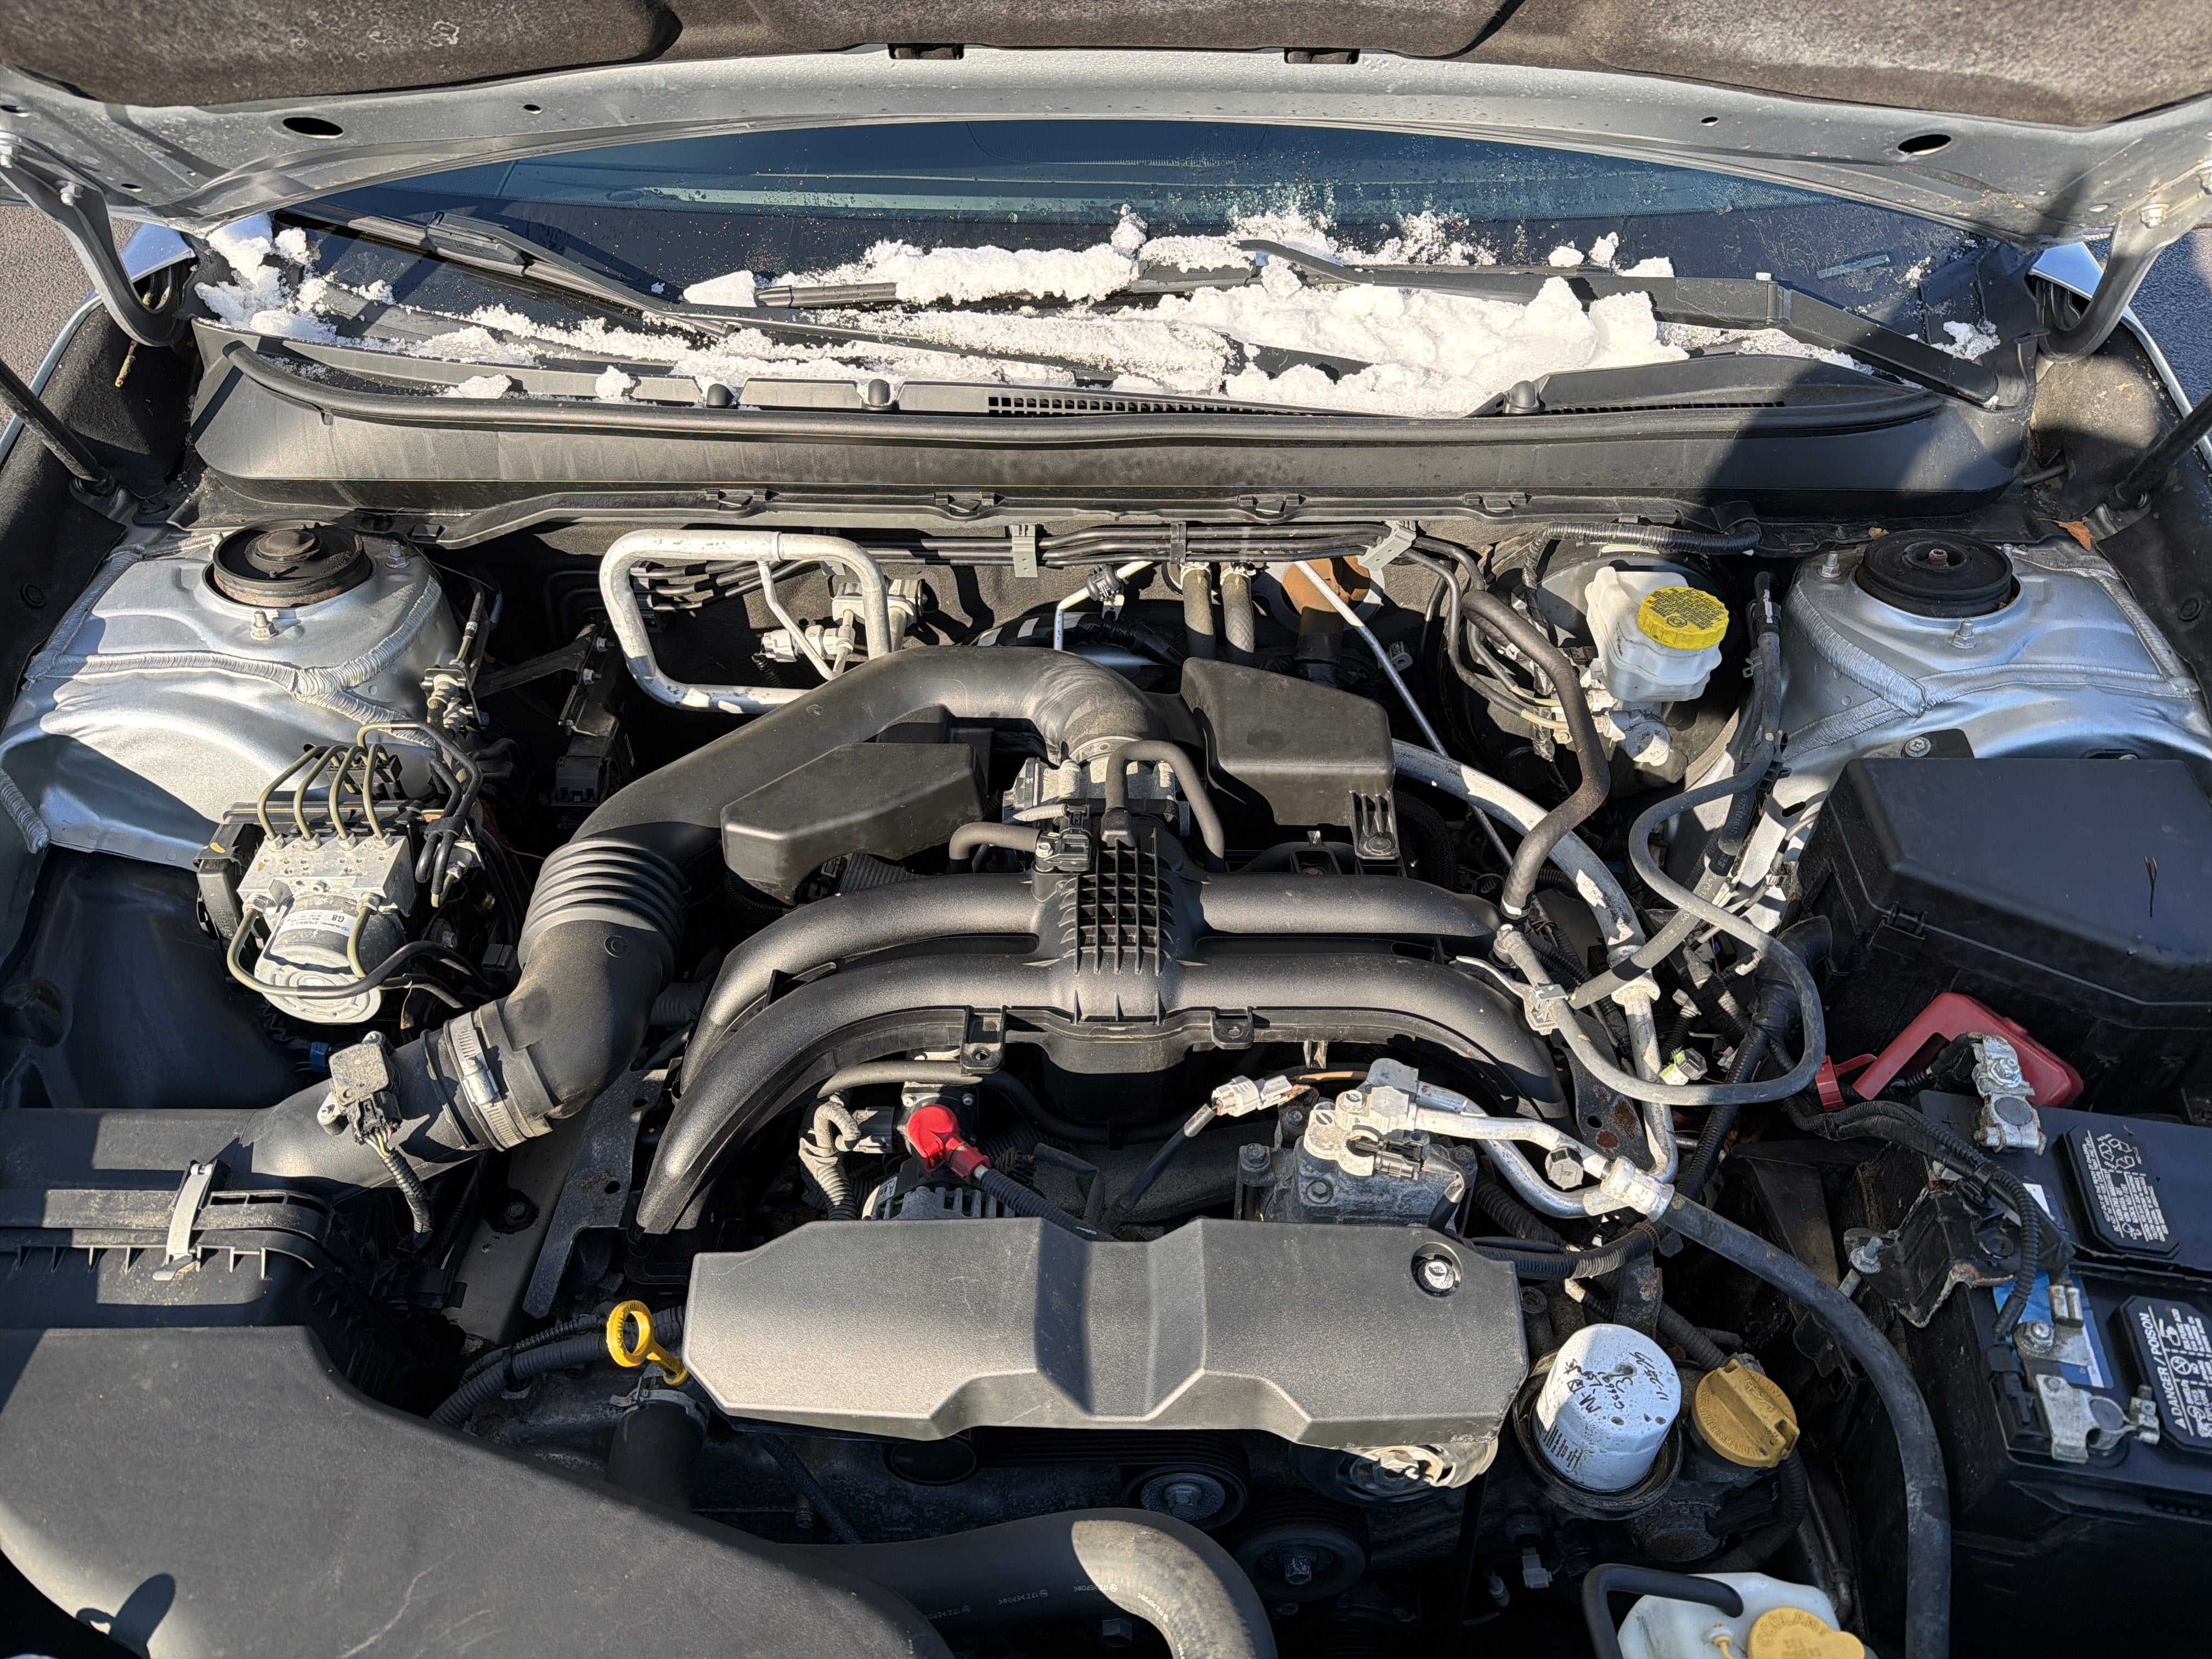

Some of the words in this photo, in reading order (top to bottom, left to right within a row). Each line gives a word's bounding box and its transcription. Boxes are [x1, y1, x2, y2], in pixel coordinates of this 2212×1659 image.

[331, 914, 345, 923] G8
[1558, 1163, 1578, 1183] H
[2138, 1312, 2163, 1356] POISON
[2157, 1366, 2183, 1417] DANGER
[1723, 1436, 1763, 1458] MANUAL
[1757, 1611, 1829, 1646] COOLANT
